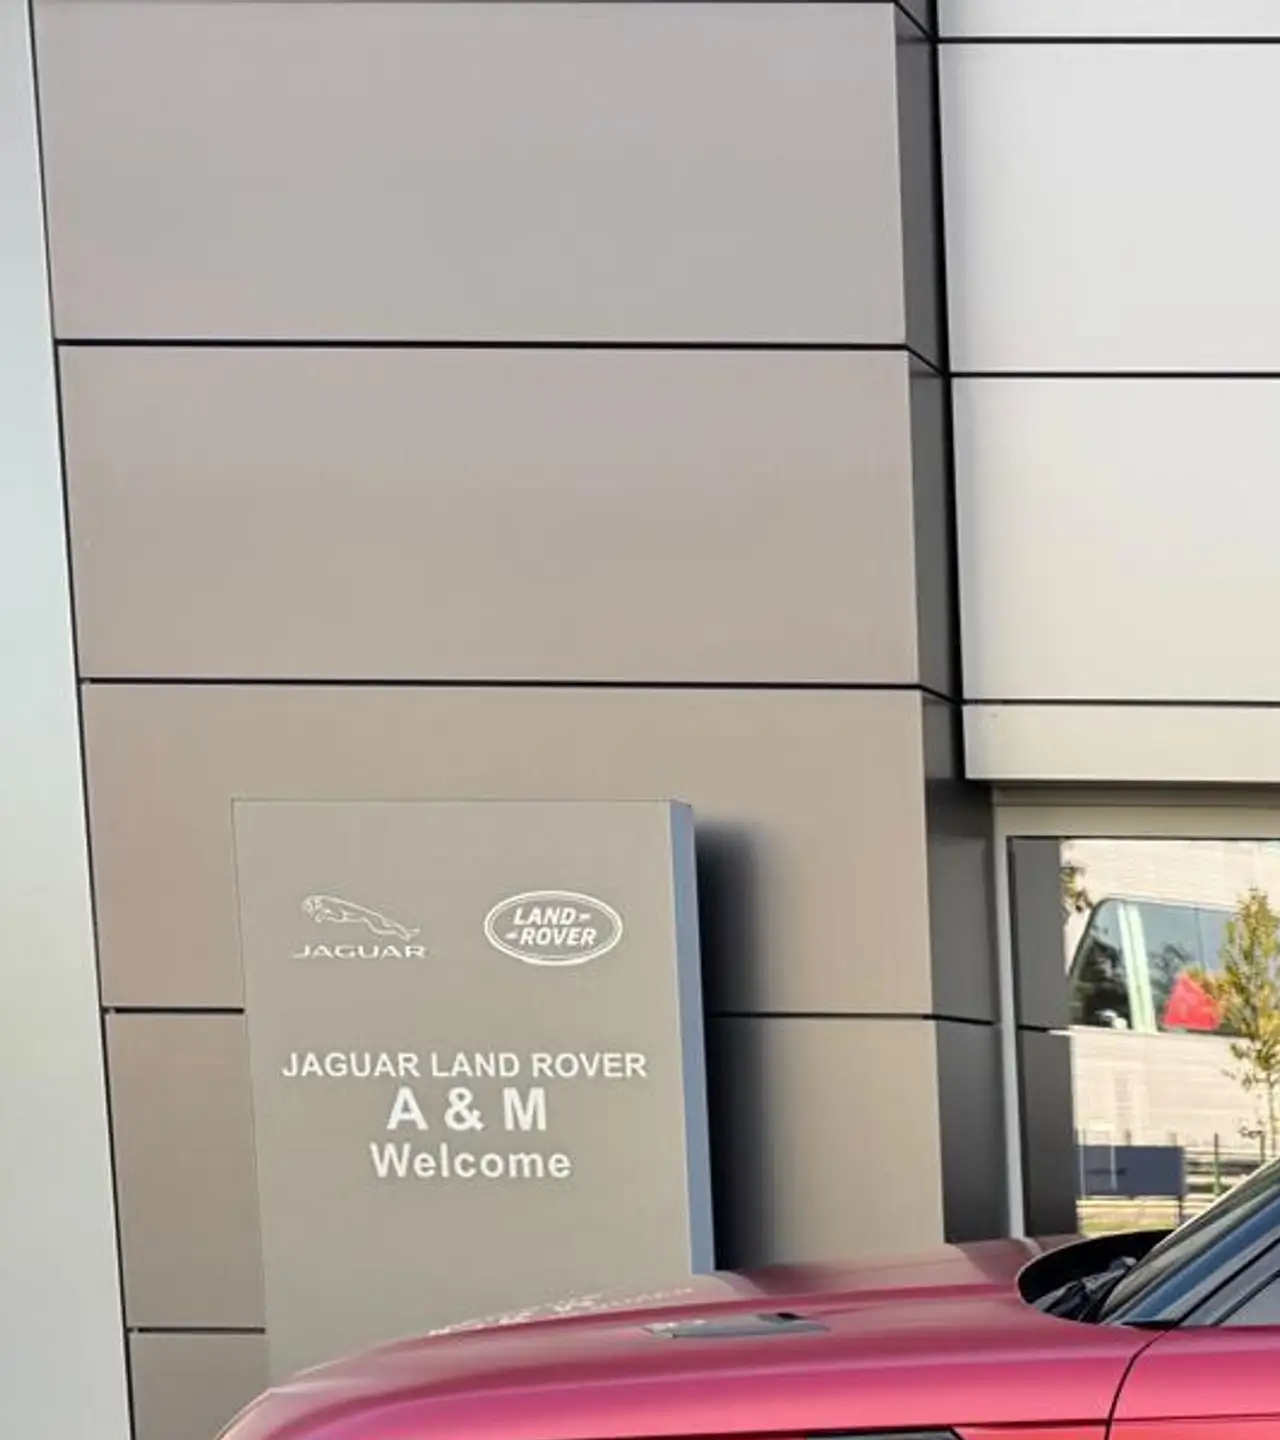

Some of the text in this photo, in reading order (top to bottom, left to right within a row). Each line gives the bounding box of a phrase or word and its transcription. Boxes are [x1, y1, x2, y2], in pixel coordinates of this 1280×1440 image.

[292, 944, 427, 960] JAGUAR
[282, 1051, 648, 1079] JAGUAR LAND ROVER
[386, 1086, 547, 1132] A & M
[369, 1142, 572, 1179] Welcome
